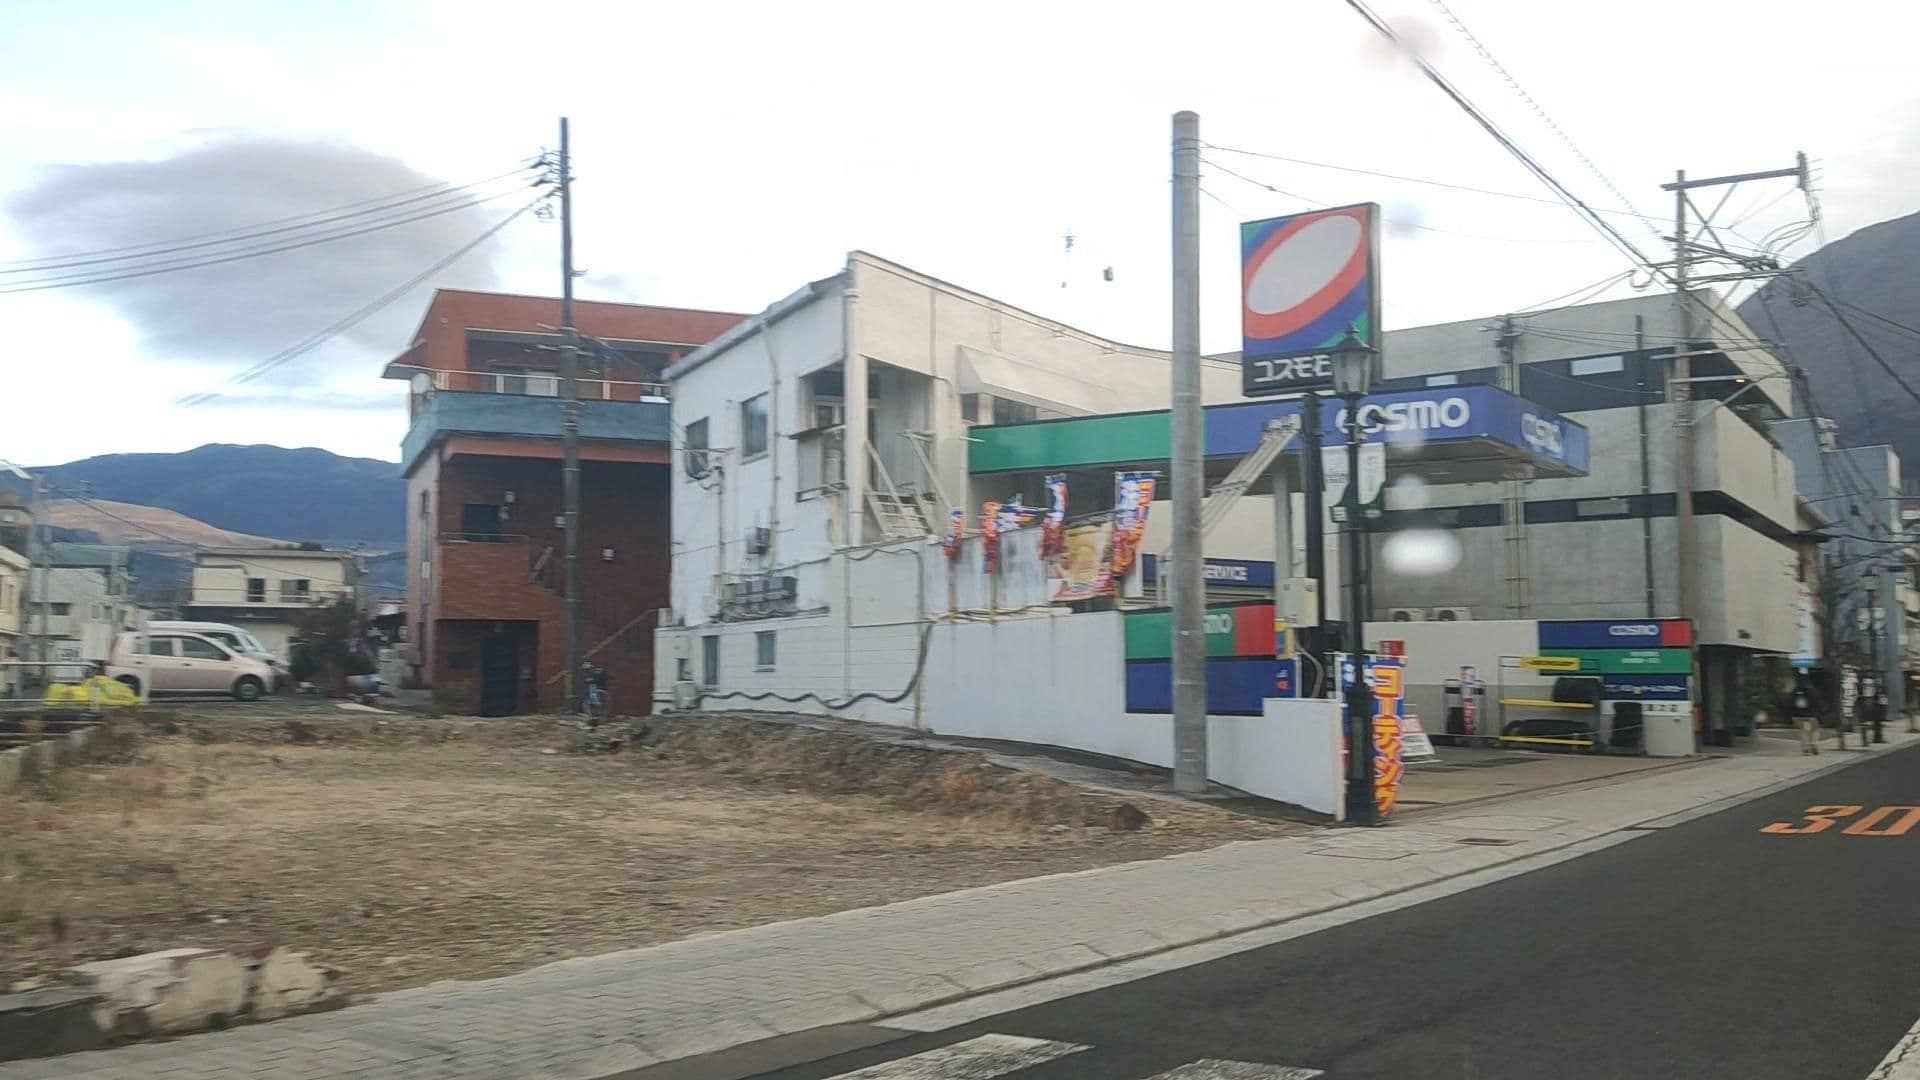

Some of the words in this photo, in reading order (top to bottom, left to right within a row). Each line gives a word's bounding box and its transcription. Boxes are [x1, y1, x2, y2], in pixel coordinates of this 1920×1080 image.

[1335, 397, 1470, 434] COSMO
[1372, 666, 1404, 818] コーティング
[1758, 805, 1920, 836] 30
